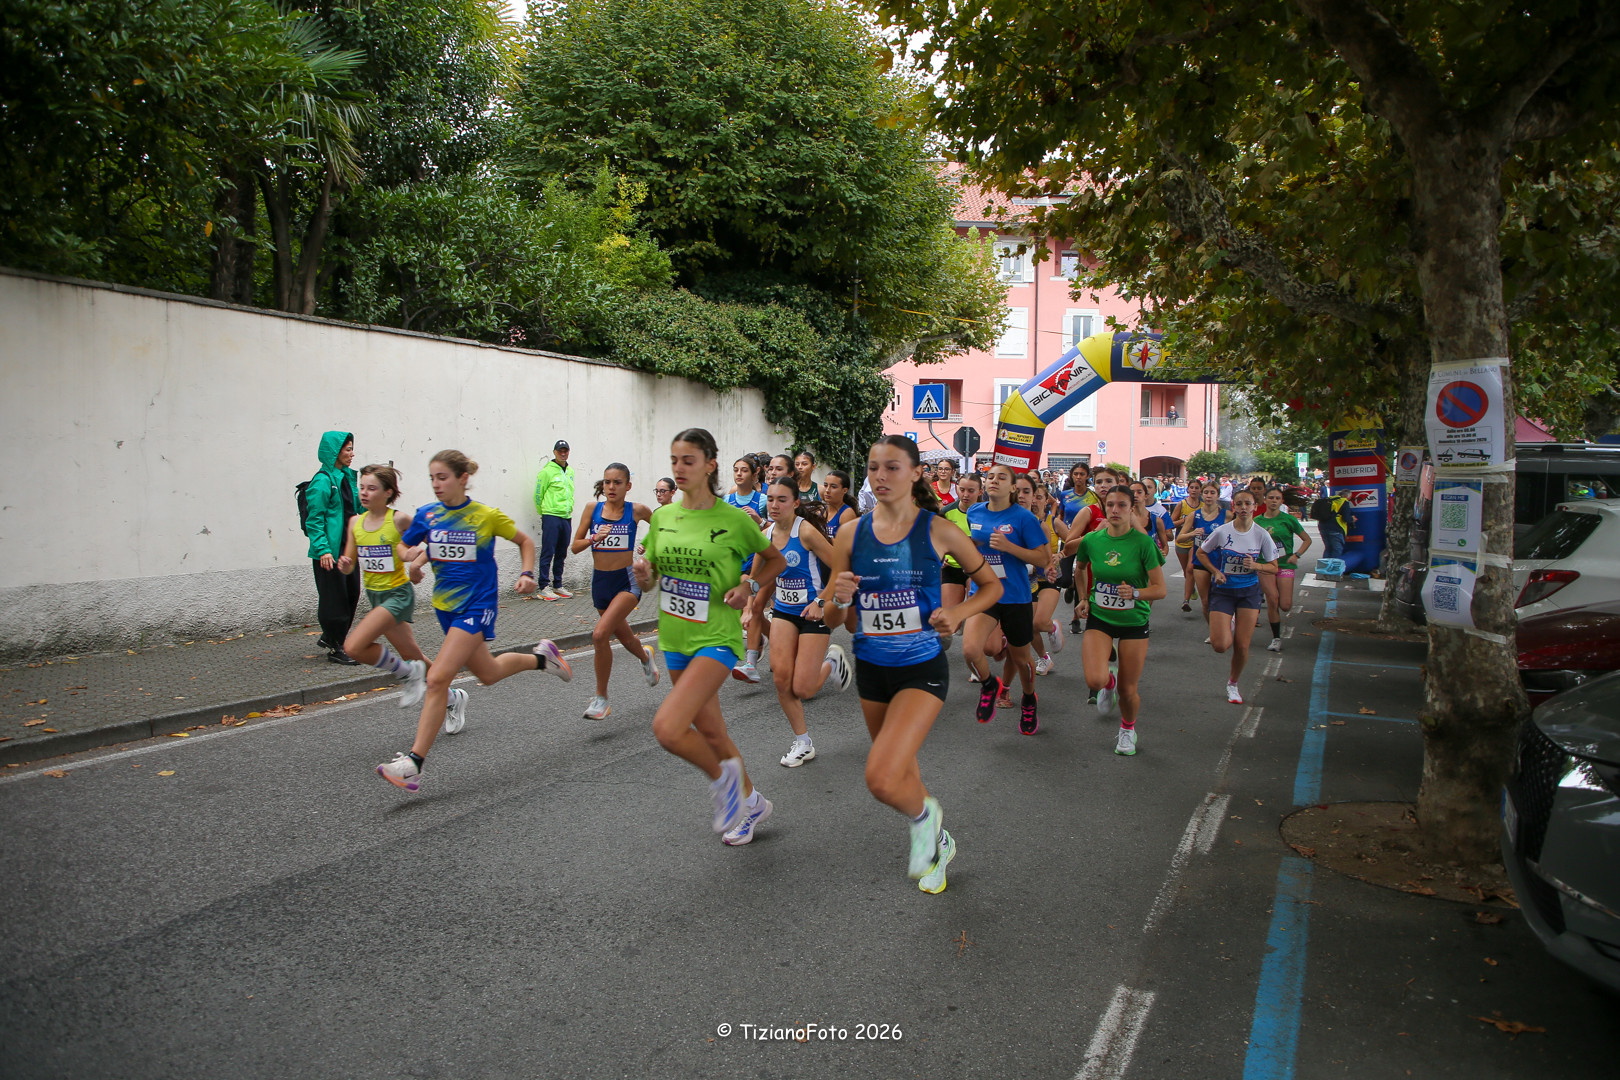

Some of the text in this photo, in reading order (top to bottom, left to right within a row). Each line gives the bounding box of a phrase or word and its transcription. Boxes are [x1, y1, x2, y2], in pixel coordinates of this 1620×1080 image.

[1029, 366, 1088, 406] BICIMANIA
[1000, 456, 1028, 466] BLUFRIDA
[1342, 466, 1377, 474] BLUFRIDA
[600, 536, 620, 547] 462
[439, 545, 465, 558] 359
[662, 546, 703, 557] AMICI
[365, 559, 385, 571] 286
[679, 582, 709, 590] CENTRO
[781, 590, 799, 602] 368
[1103, 595, 1125, 607] 373
[670, 596, 695, 616] 538
[881, 599, 916, 607] ITALIANO
[872, 611, 906, 630] 454
